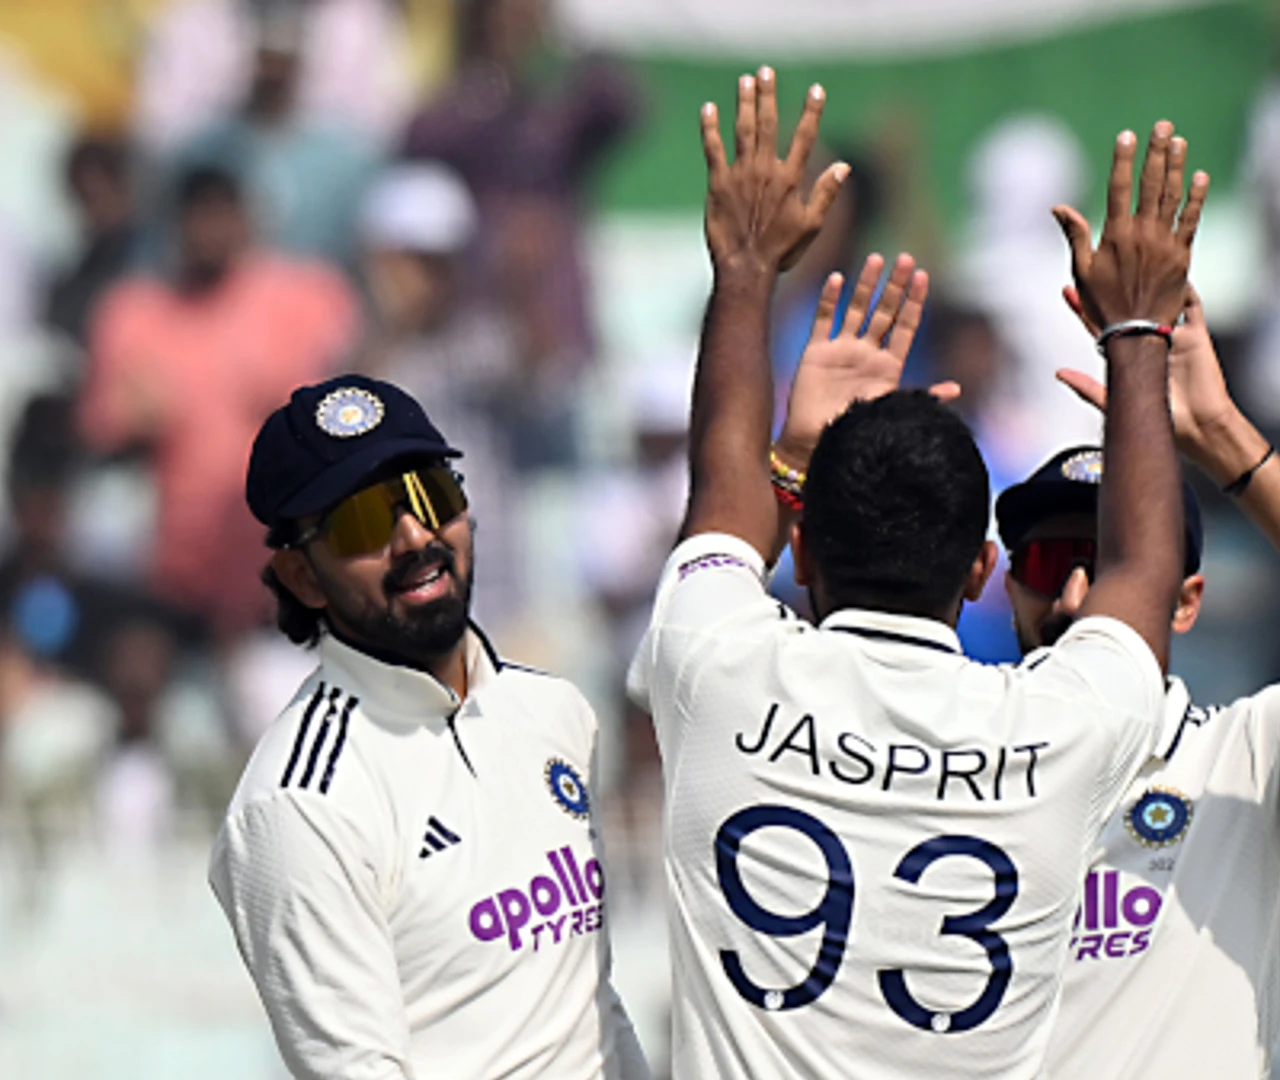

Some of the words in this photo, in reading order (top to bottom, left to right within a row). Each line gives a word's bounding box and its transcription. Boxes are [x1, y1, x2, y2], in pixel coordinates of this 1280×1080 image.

[734, 703, 1050, 801] JASPRIT
[467, 844, 606, 951] apollo
[713, 803, 1020, 1035] 93
[1070, 928, 1152, 961] RES
[1072, 869, 1163, 931] llo
